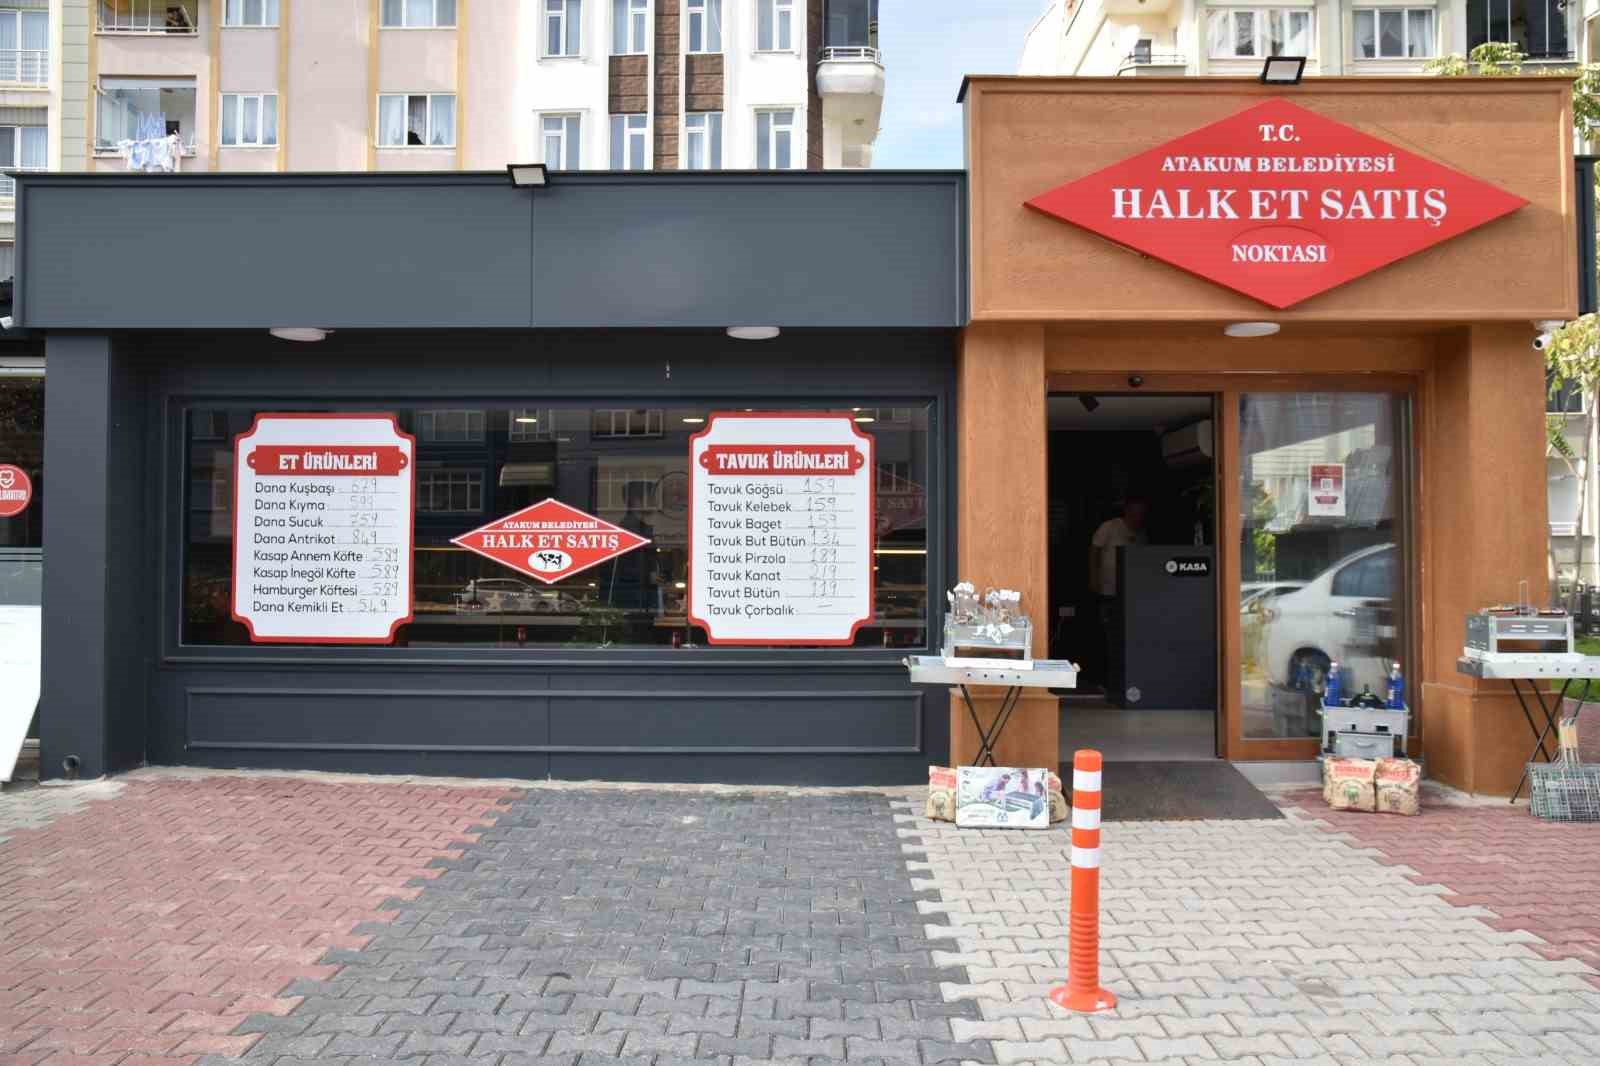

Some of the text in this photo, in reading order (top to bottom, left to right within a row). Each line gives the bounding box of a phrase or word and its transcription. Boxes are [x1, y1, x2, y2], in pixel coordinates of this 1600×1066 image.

[1258, 125, 1300, 142] T.C.
[1162, 153, 1395, 172] ATAKUM BELEDİYESİ
[1112, 189, 1447, 226] HALK ET SATIŞ
[1232, 244, 1327, 262] NOKTASI
[279, 452, 377, 470] ET ÜRÜNLERİ
[716, 451, 848, 469] TAVUK ÜRÜNLERİ
[255, 483, 286, 493] Dana
[290, 483, 335, 497] Kuşbaşı
[708, 484, 742, 495] Tavuk
[746, 482, 783, 498] Göğsü
[255, 500, 285, 510] Dana
[290, 500, 325, 513] Kıyma
[708, 501, 742, 512] Tavuk
[746, 501, 792, 512] Kelebek
[254, 517, 285, 527] Dana
[289, 517, 323, 528] Sucuk
[542, 521, 597, 529] BELEDİYESİ
[708, 518, 742, 529] Tavuk
[746, 518, 781, 532] Baget
[254, 534, 285, 544] Dana
[288, 534, 335, 544] Antrikot
[483, 534, 618, 550] HALK ET SATIŞ
[708, 536, 742, 546] Tavuk
[746, 536, 766, 547] But
[770, 536, 805, 547] Bütün
[254, 551, 288, 564] Kasap
[291, 551, 330, 561] Annem
[334, 550, 363, 562] Köfte
[708, 553, 742, 563] Tavuk
[746, 552, 785, 564] Pirzola
[253, 568, 288, 581] Kasap
[291, 566, 324, 581] İnegöl
[326, 567, 355, 578] Köfte
[1179, 563, 1207, 571] KASA
[707, 570, 742, 581] Tavuk
[746, 570, 781, 581] Kanat
[253, 585, 317, 598] Hamburger
[320, 585, 357, 596] Köftesi
[707, 587, 741, 598] Tavut
[744, 586, 780, 598] Bütün
[253, 602, 284, 613] Dana
[288, 602, 328, 613] Kemikli
[332, 602, 344, 613] Et
[707, 604, 794, 619] Tavuk Çorbalık
